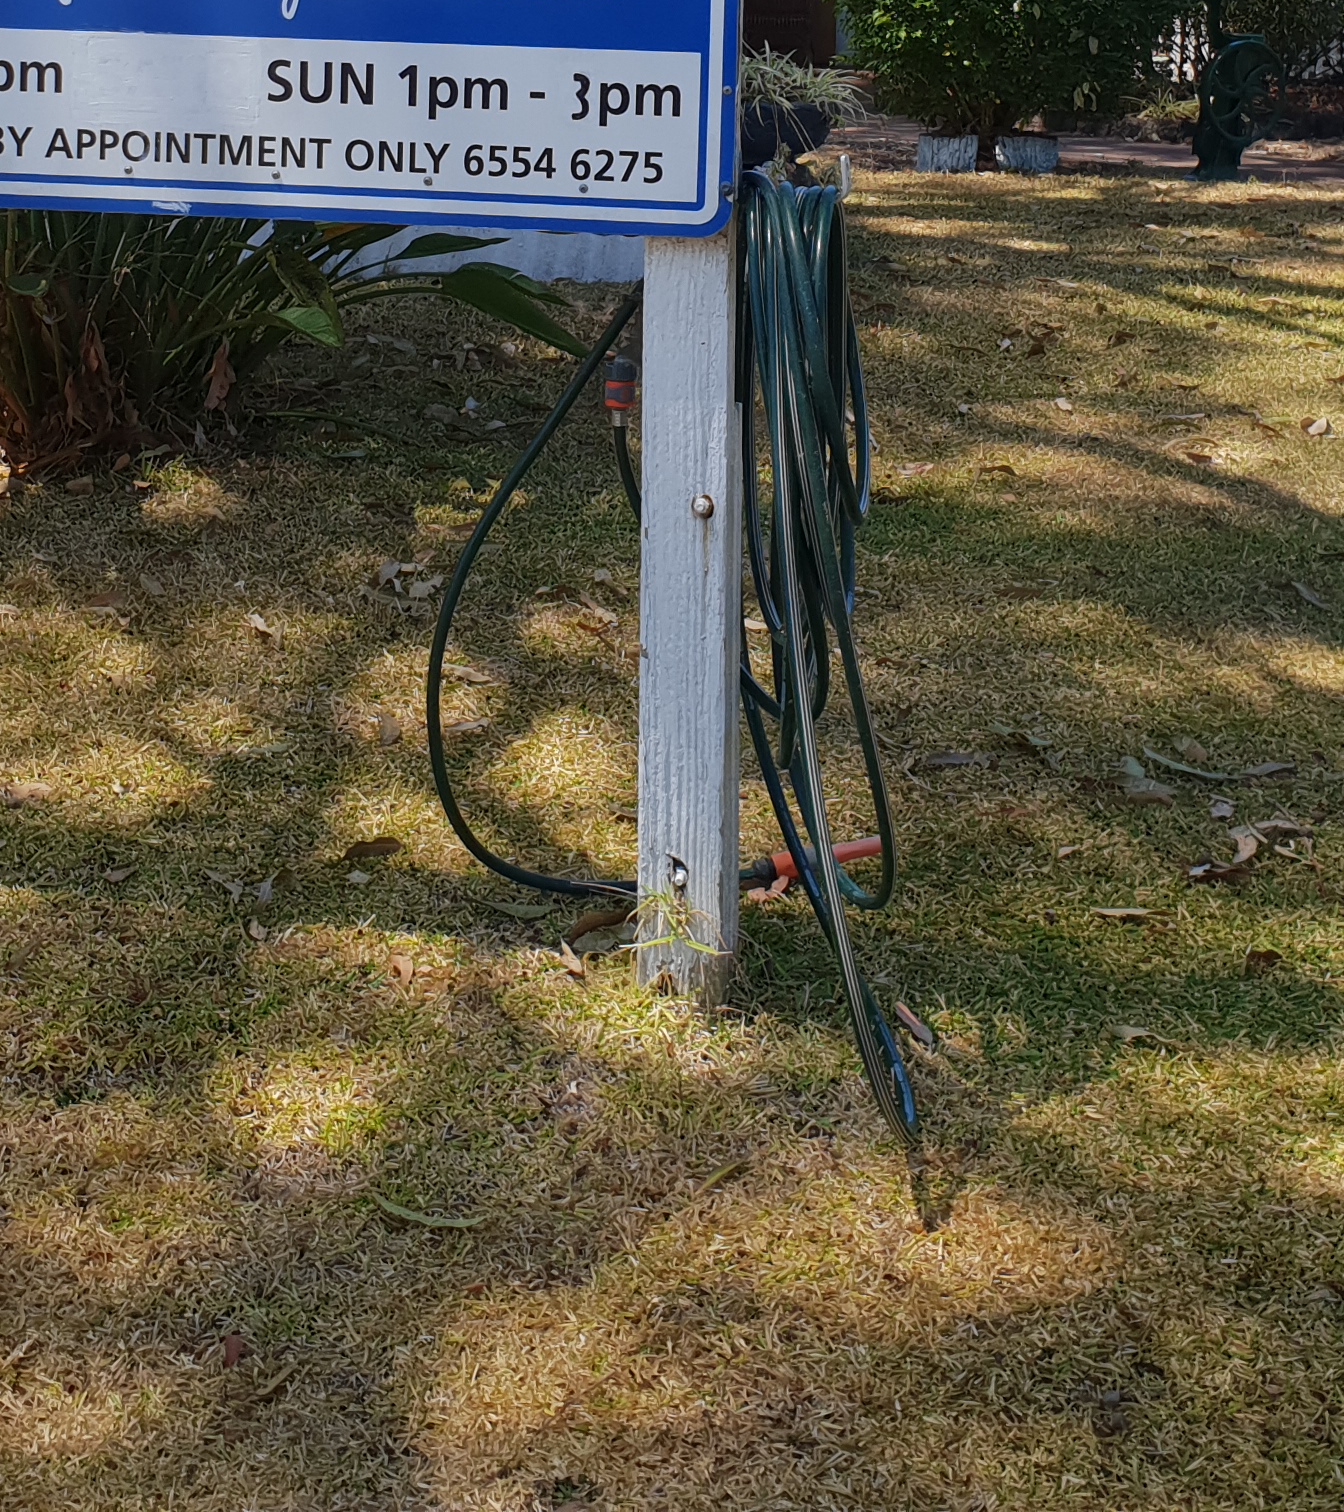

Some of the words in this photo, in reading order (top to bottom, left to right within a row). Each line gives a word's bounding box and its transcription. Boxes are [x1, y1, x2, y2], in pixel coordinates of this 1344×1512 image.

[267, 59, 375, 106] SUN
[398, 67, 509, 119] 1pm
[572, 73, 683, 126] 3pm
[45, 128, 333, 169] APPOINTMENT
[345, 139, 451, 175] ONLY
[463, 144, 556, 180] 6554
[570, 149, 665, 183] 6275
